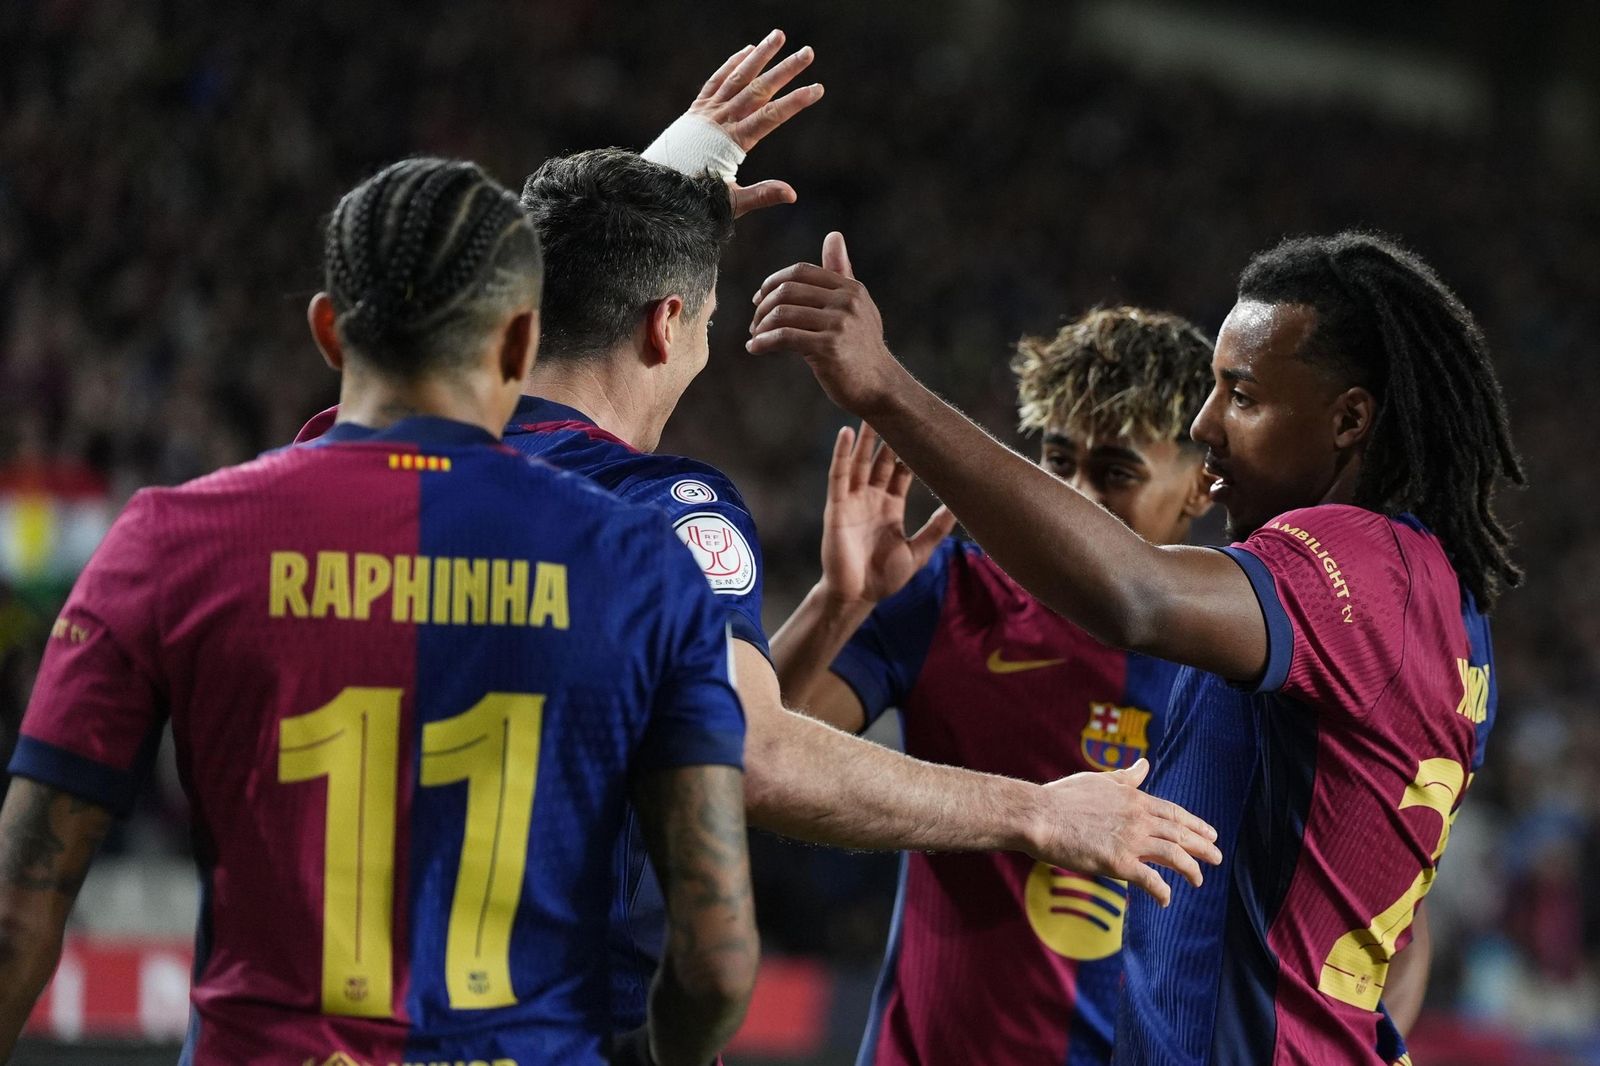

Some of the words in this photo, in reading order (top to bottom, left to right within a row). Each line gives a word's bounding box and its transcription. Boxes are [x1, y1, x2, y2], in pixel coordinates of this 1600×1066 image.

[682, 488, 707, 498] 31
[269, 551, 570, 630] RAPHINHA
[1270, 522, 1350, 598] AMBILIGHT
[1341, 604, 1353, 623] tv
[278, 687, 547, 1019] 11
[1318, 757, 1475, 1012] 2
